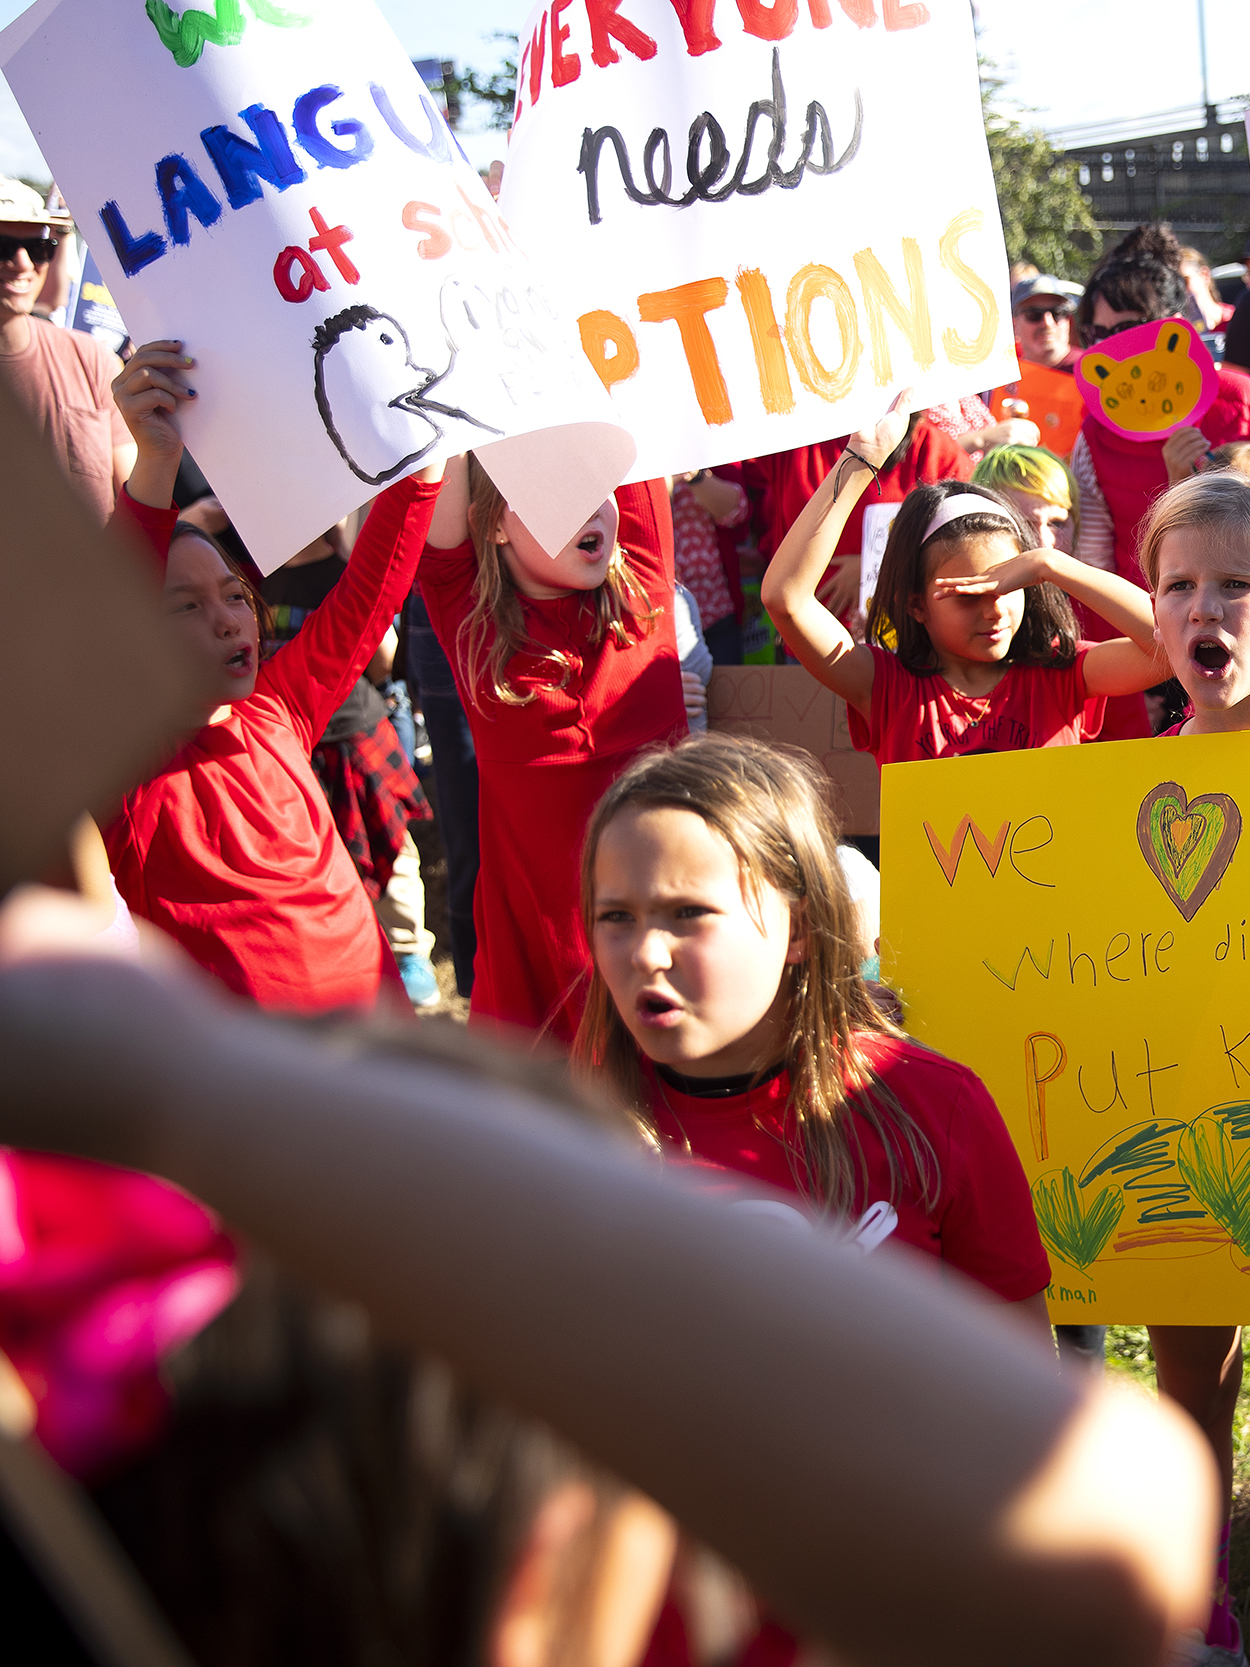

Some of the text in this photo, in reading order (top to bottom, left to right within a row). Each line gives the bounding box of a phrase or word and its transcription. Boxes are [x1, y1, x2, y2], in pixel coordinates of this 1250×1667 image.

[98, 80, 470, 278] LANGU
[577, 46, 863, 224] needs
[273, 206, 360, 303] at
